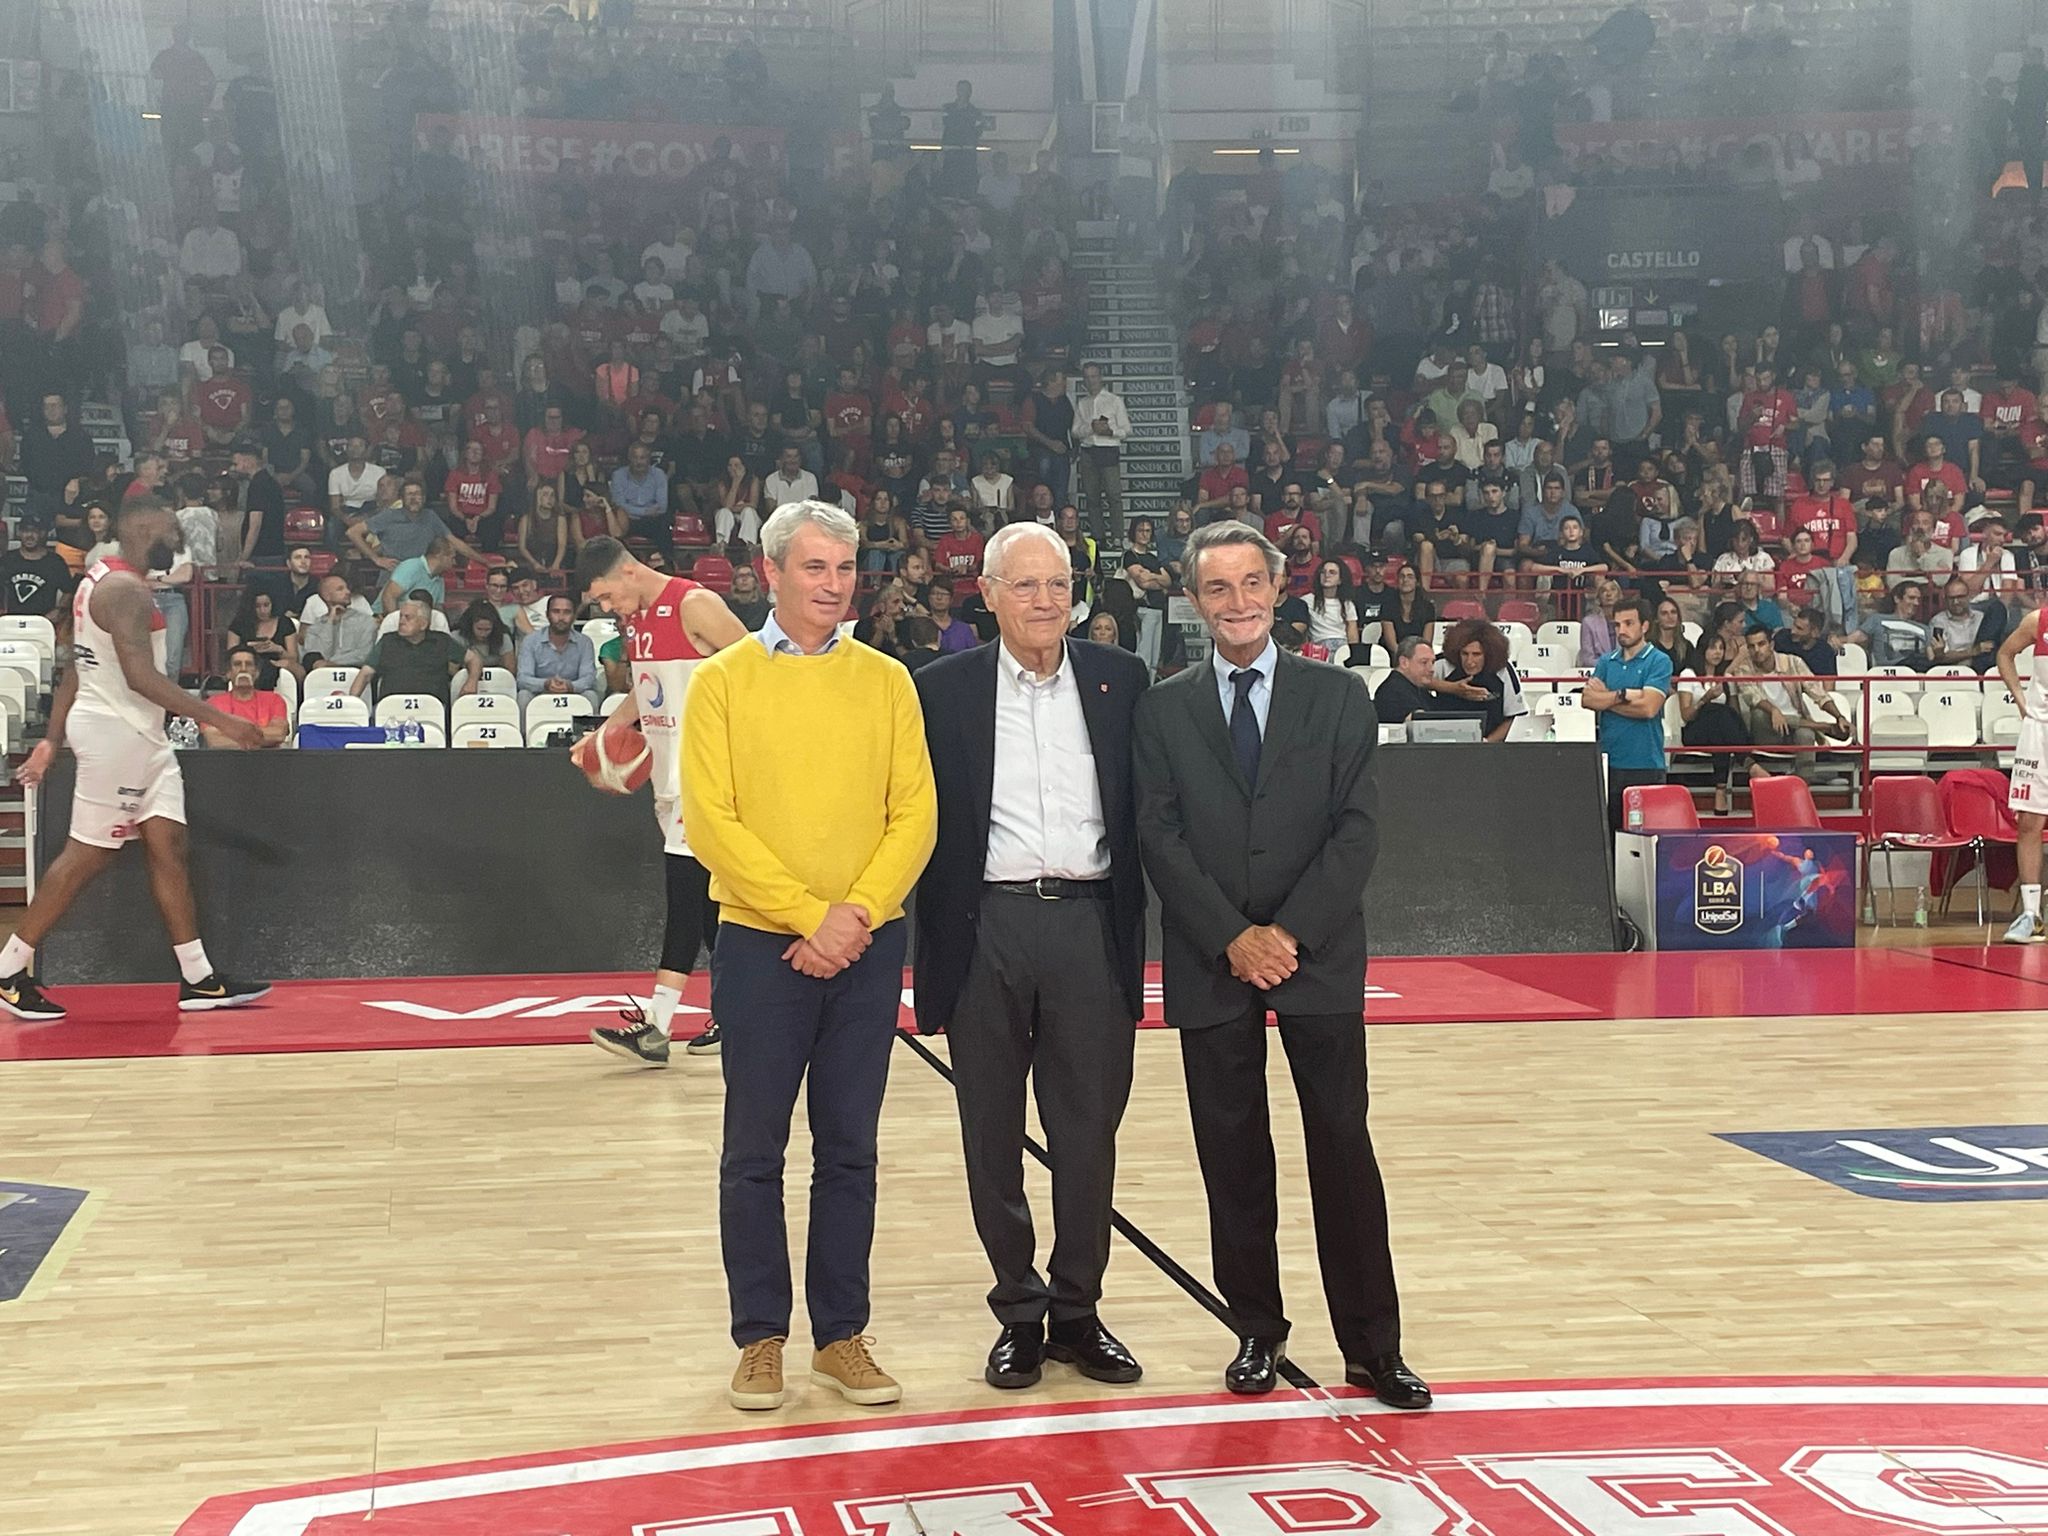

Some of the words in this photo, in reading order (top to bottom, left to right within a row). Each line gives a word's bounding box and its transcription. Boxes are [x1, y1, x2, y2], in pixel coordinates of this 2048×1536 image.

[1607, 251, 1700, 269] CASTELLO
[1996, 405, 2022, 423] RUN
[1134, 426, 1179, 436] ANPAOLO
[1130, 462, 1181, 473] SANPAOLO
[634, 631, 653, 659] 12
[1537, 647, 1549, 657] 31
[326, 699, 343, 710] 20
[404, 699, 420, 709] 21
[478, 698, 494, 708] 22
[553, 697, 568, 708] 23
[1558, 696, 1573, 706] 35
[1877, 694, 1892, 704] 40
[1939, 696, 1952, 706] 41
[479, 728, 497, 739] 23
[2011, 783, 2032, 801] ail
[1702, 881, 1738, 896] LBA
